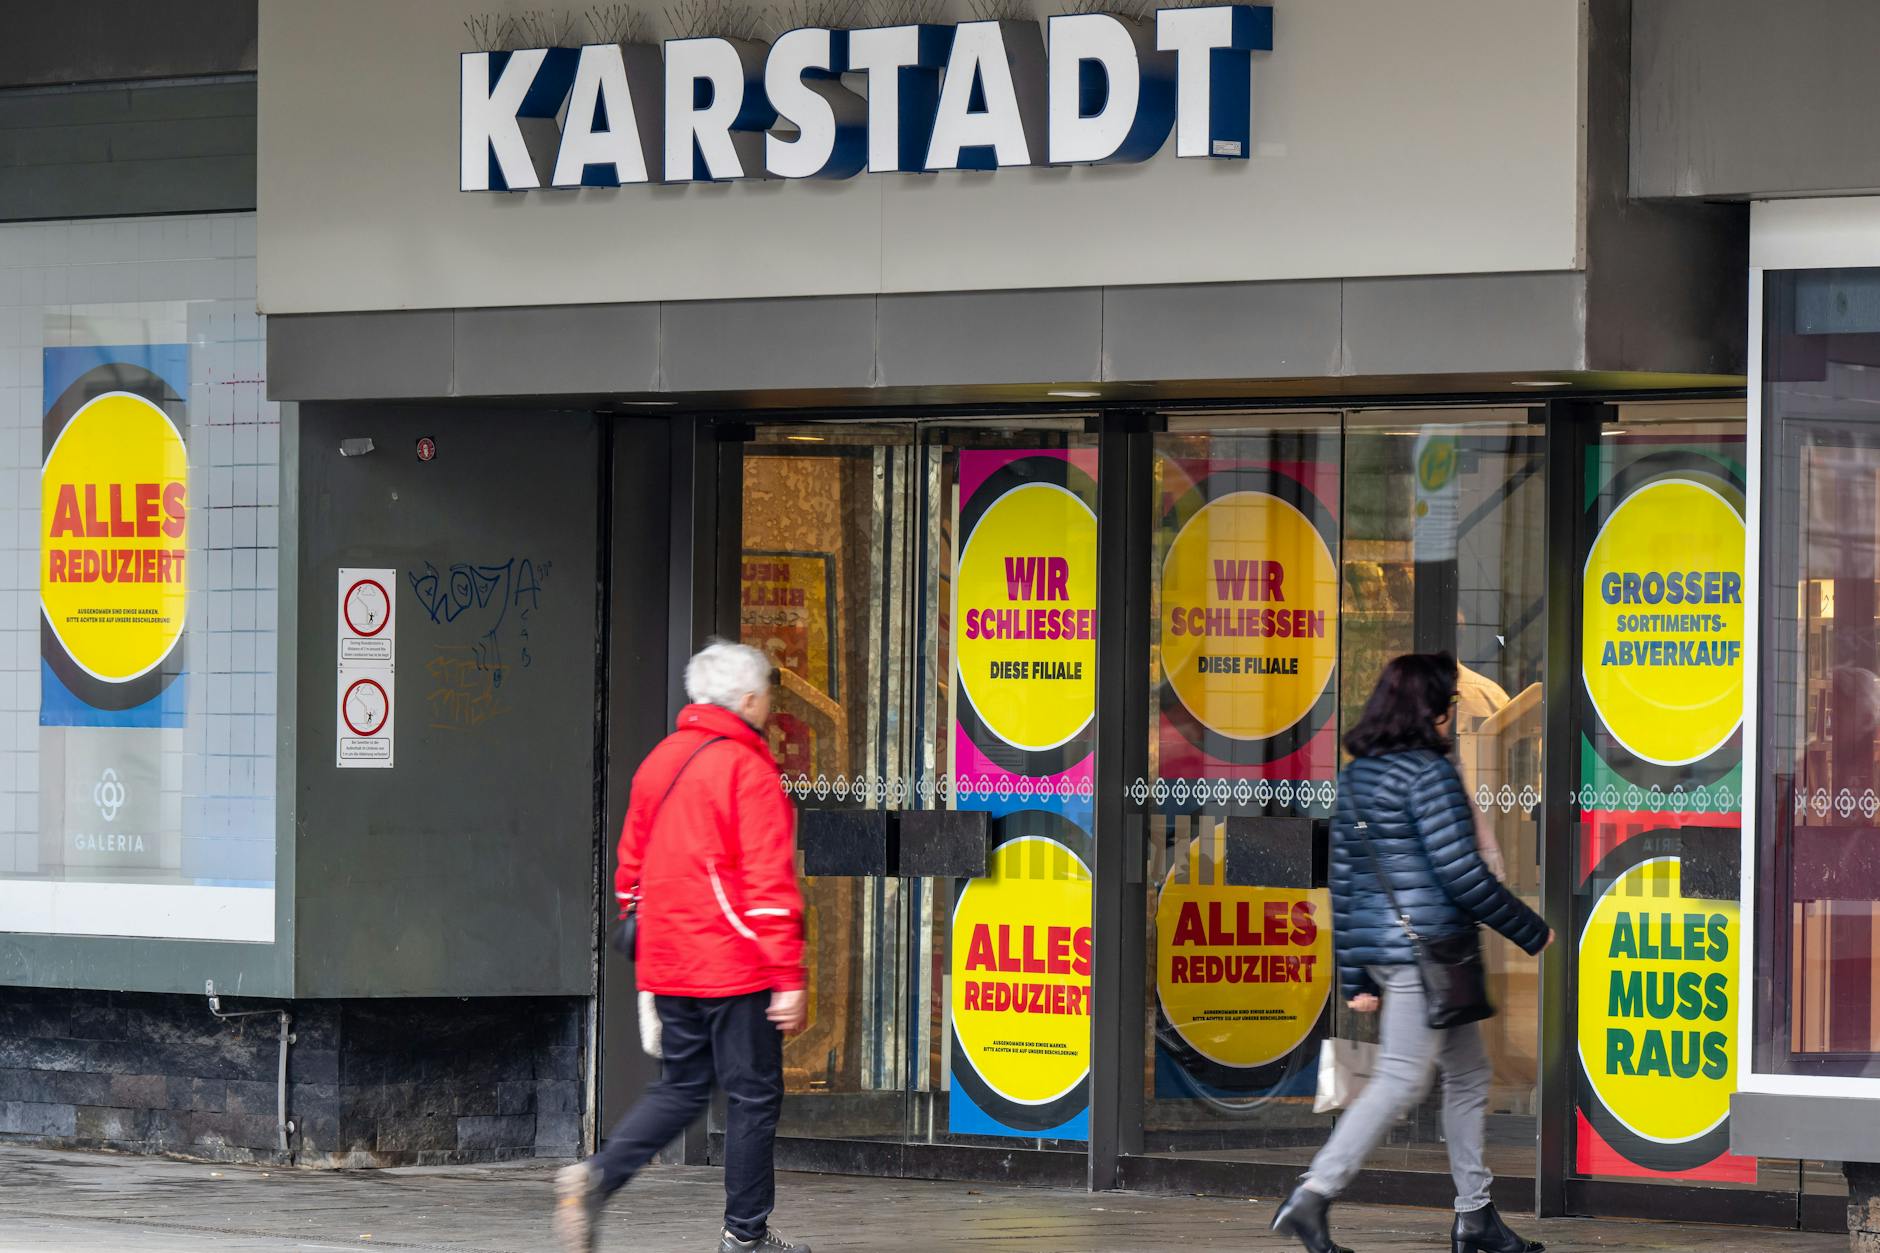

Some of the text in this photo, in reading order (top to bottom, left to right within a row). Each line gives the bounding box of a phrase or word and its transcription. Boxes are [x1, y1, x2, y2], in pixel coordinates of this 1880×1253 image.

[460, 6, 1240, 192] KARSTADT
[49, 481, 186, 539] ALLES
[49, 548, 185, 584] REDUZIERT
[1004, 557, 1069, 601] WIR
[1213, 559, 1285, 602] WIR
[1601, 571, 1742, 605] GROSSER
[1170, 606, 1325, 638] SCHLIESSEN
[1616, 614, 1727, 633] SORTIMENTS-
[990, 661, 1082, 680] DIESE FILIALE
[1198, 656, 1298, 675] DIESE FILIALE
[1601, 640, 1741, 666] ABVERKAUF
[74, 834, 144, 852] GALERIA
[1171, 900, 1318, 947] ALLES
[1608, 911, 1729, 963] ALLES
[965, 923, 1092, 977] ALLES
[1171, 955, 1316, 984] REDUZIERT
[1608, 970, 1729, 1022] MUSS
[1605, 1028, 1729, 1081] RAUS
